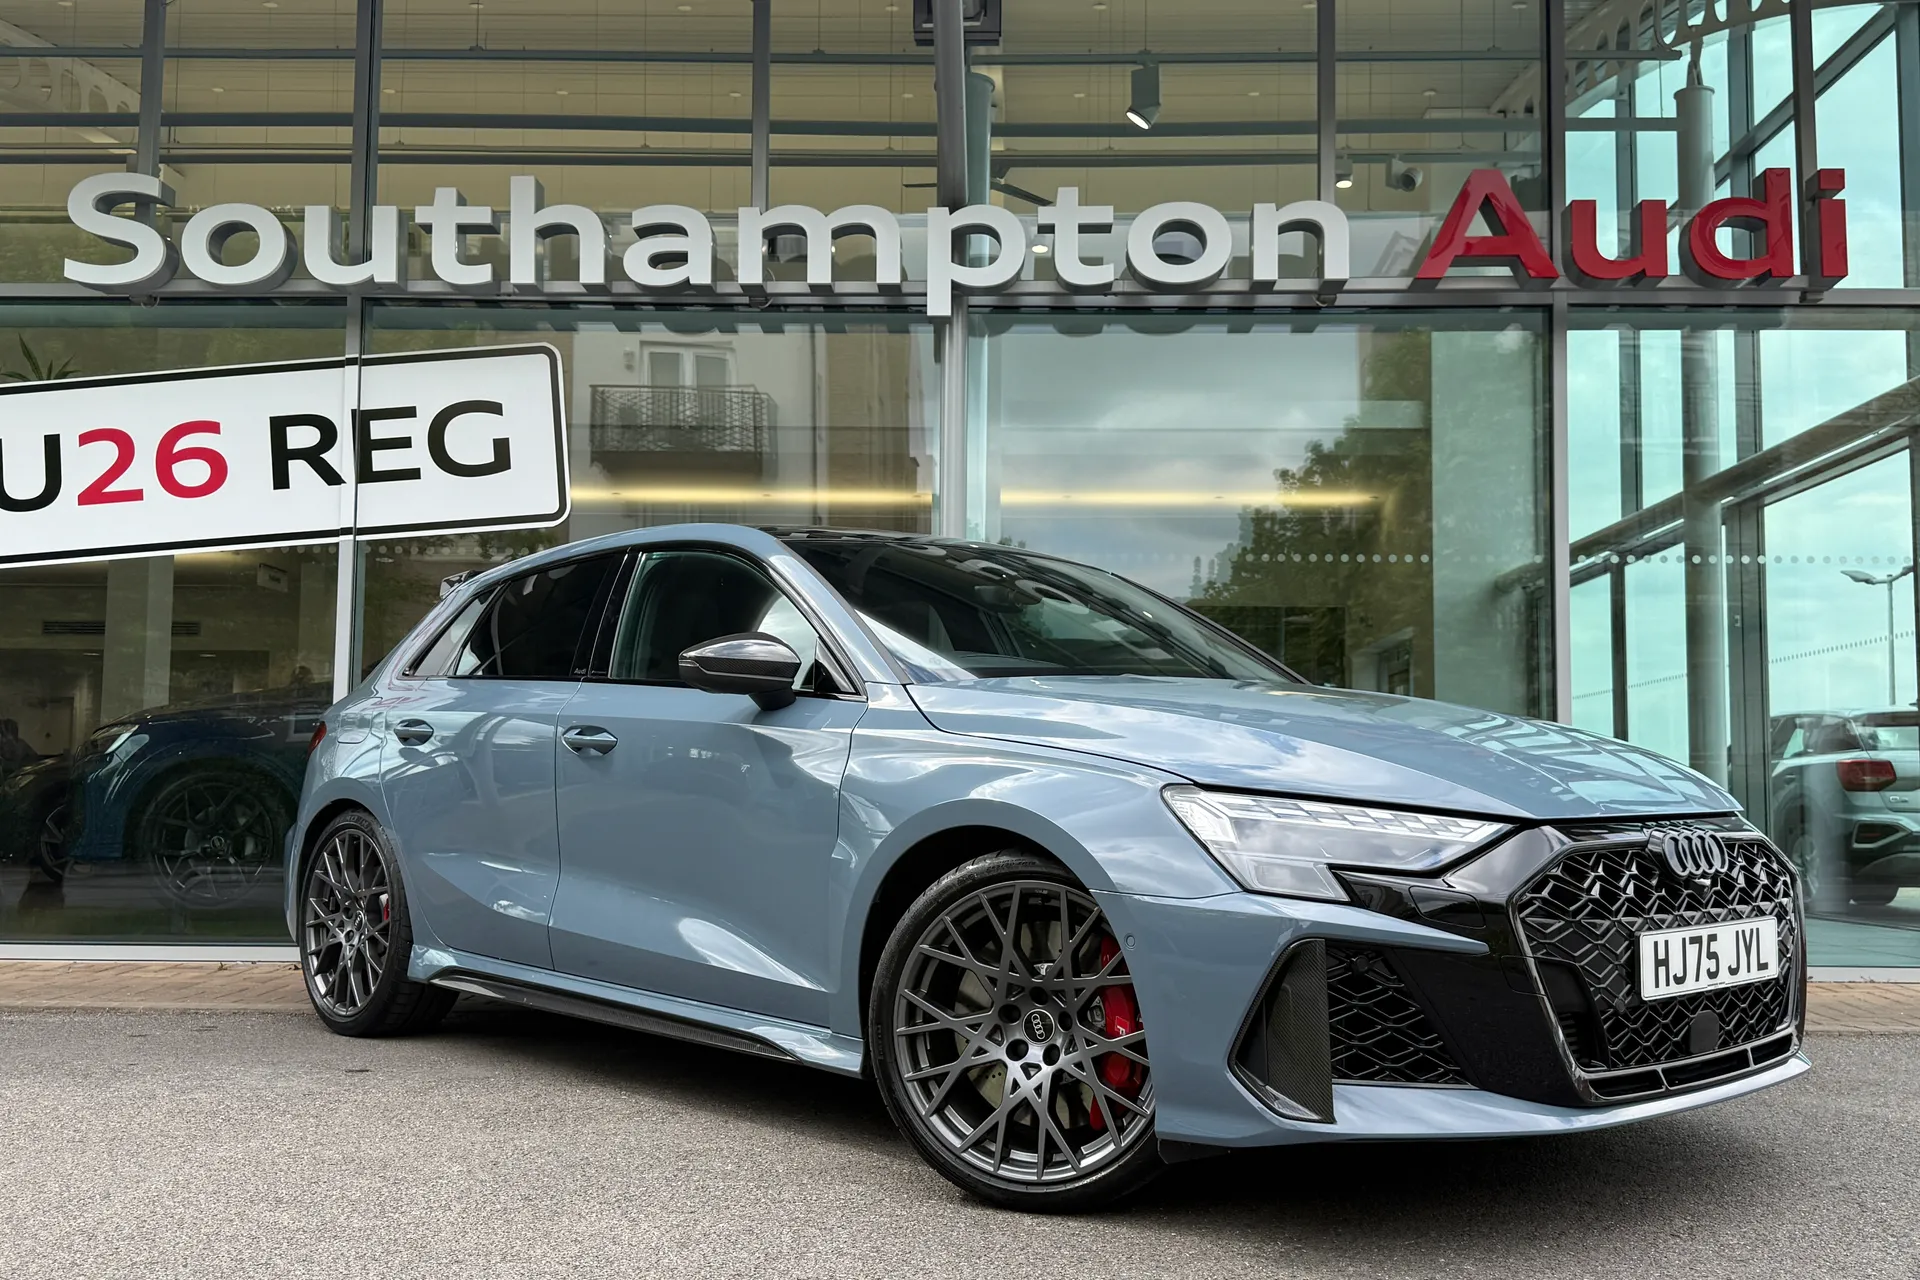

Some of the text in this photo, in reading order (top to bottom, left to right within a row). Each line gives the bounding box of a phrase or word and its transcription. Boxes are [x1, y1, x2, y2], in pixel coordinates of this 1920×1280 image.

[64, 168, 1848, 316] Southampton Audi
[269, 399, 512, 490] REG
[1653, 927, 1769, 988] HJ75 JYL
